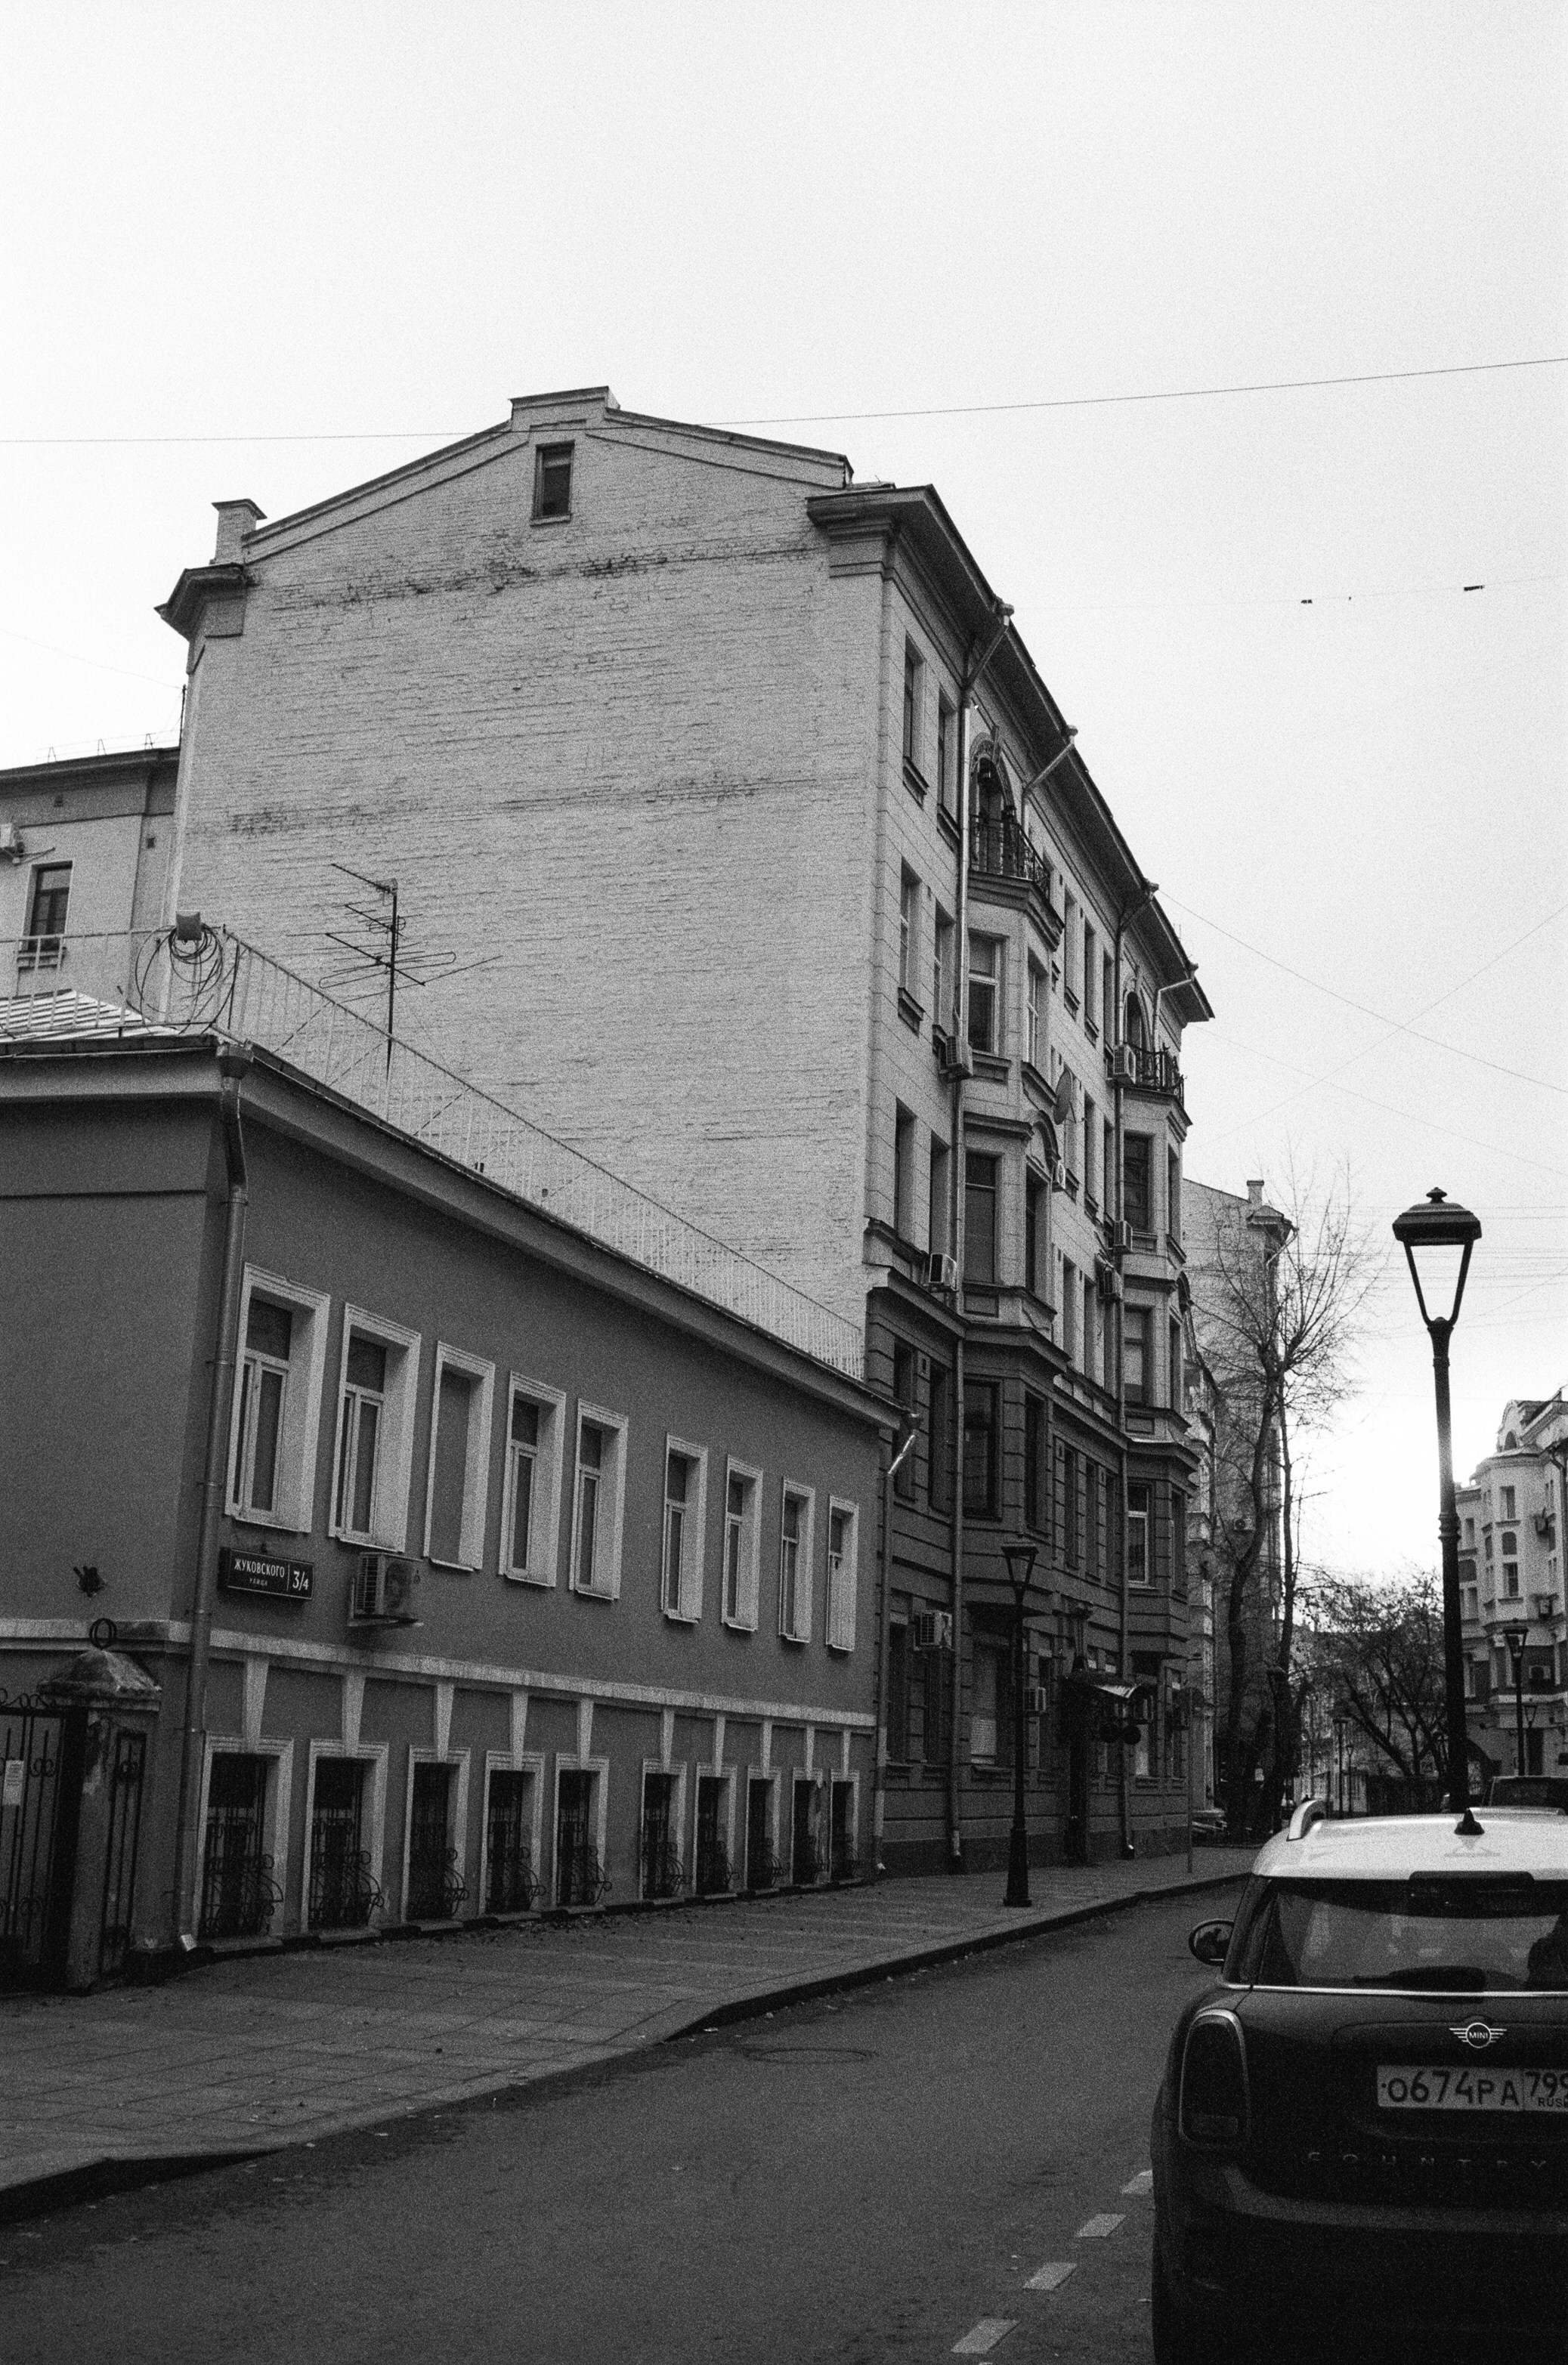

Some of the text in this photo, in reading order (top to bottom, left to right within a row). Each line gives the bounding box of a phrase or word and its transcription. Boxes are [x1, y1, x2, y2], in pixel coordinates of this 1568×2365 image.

[233, 1558, 285, 1578] ЖУКОВСКОГО
[292, 1570, 309, 1591] 3/4
[1468, 2030, 1489, 2040] MINI
[1538, 2098, 1563, 2107] RUS
